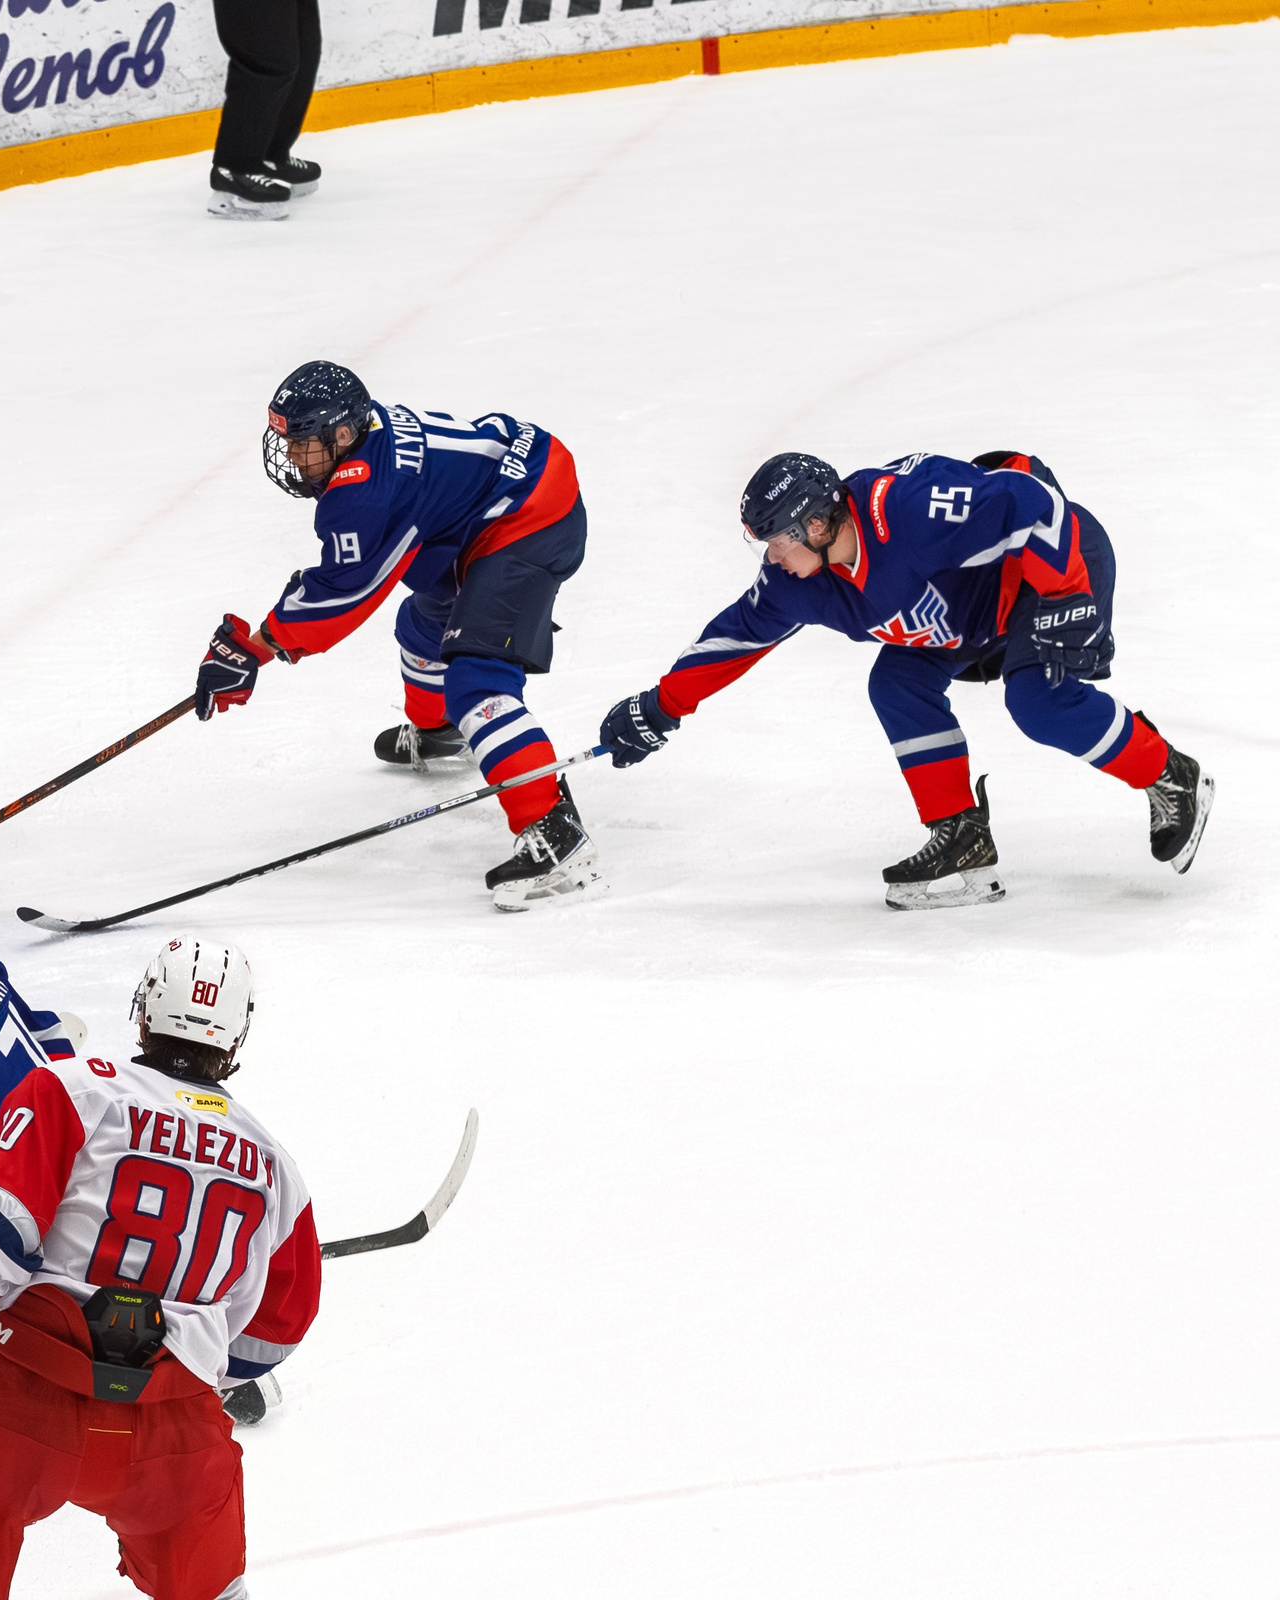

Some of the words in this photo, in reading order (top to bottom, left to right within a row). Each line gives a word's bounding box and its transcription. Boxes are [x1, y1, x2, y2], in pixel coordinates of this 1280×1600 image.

[764, 473, 795, 501] Vorgol
[872, 478, 888, 537] OLIMPBET
[928, 486, 973, 523] 25
[331, 532, 362, 564] 19
[191, 980, 219, 1007] 80
[196, 1099, 224, 1109] БАНК
[86, 1154, 267, 1306] 80
[115, 1295, 142, 1303] TACKS
